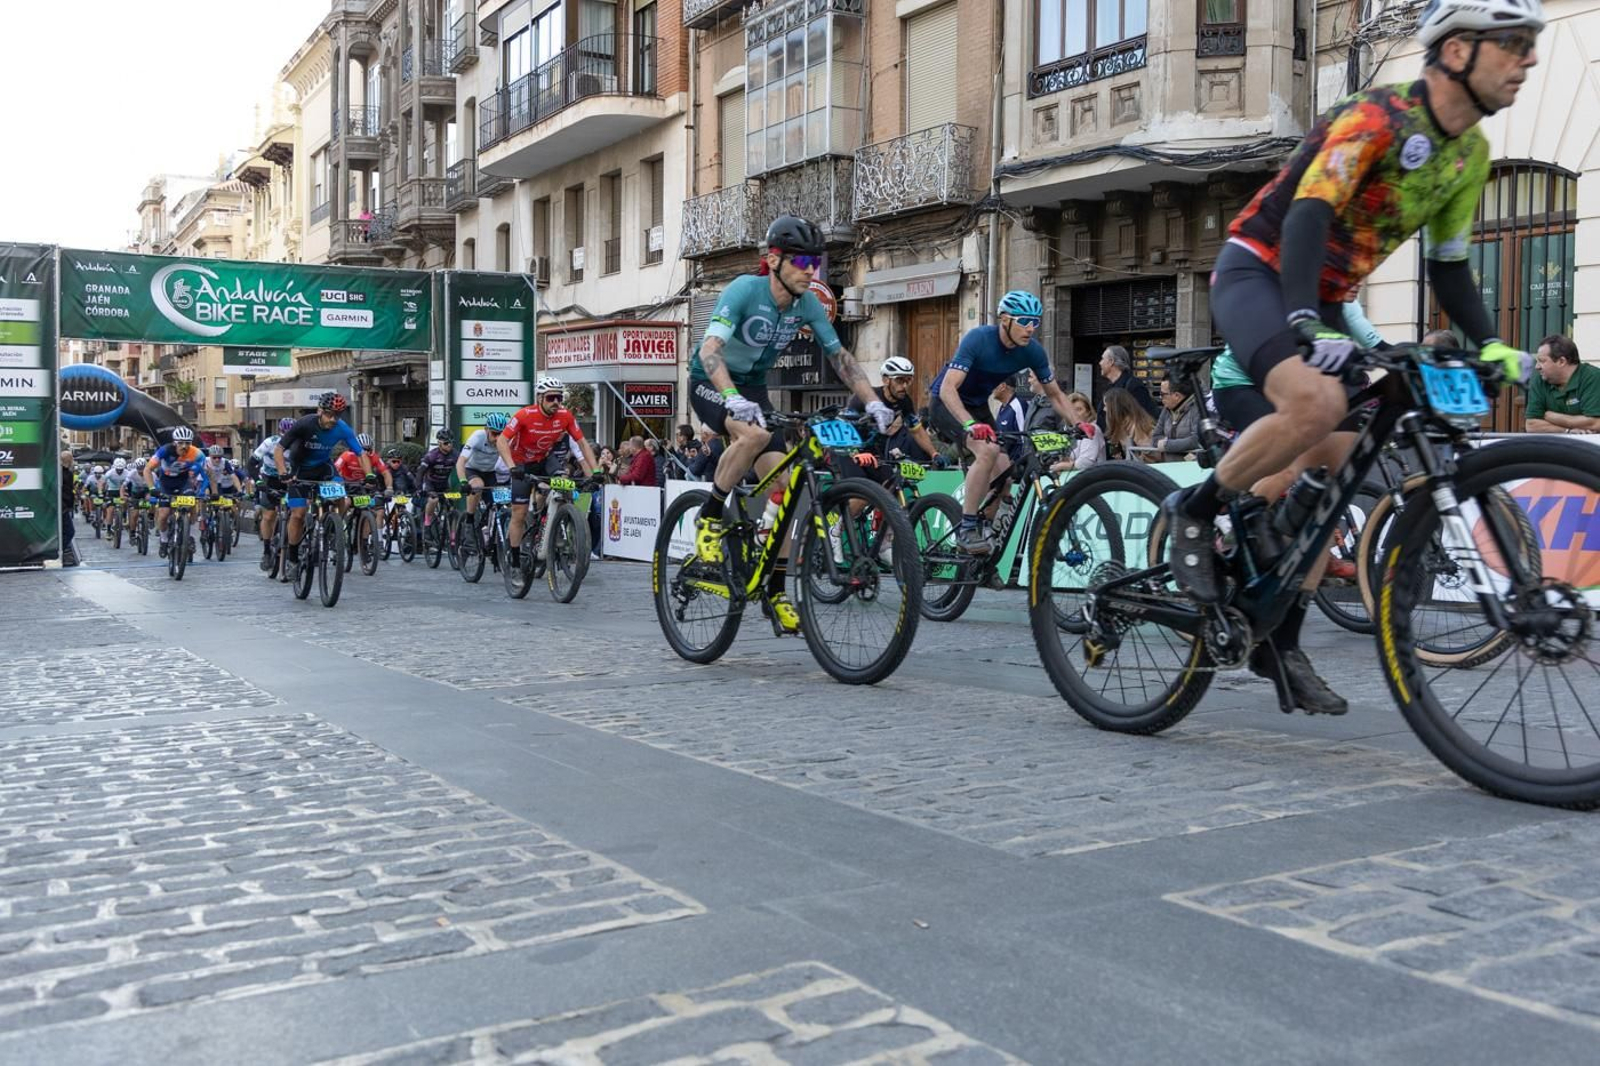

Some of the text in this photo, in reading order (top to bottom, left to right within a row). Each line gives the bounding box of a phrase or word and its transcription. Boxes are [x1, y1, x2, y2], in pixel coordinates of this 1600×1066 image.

[85, 284, 130, 294] GRANADA
[195, 273, 312, 306] Andalucía
[86, 295, 110, 304] JAÉN
[86, 306, 130, 317] CÓRDOBA
[196, 302, 314, 326] BIKE RACE
[327, 314, 368, 322] GARMIN
[622, 330, 675, 339] OPORTUNIDADES
[548, 331, 618, 360] OPORTUNIDADES JAVIER
[624, 340, 675, 353] JAVIER
[564, 355, 572, 363] EN
[573, 352, 591, 362] TELAS
[61, 391, 119, 401] ARMIN
[466, 388, 518, 397] GARMIN
[629, 395, 668, 404] JAVIER
[321, 487, 343, 497] 419-1
[624, 516, 657, 528] AYUNTAMIENTO
[623, 528, 632, 537] DE
